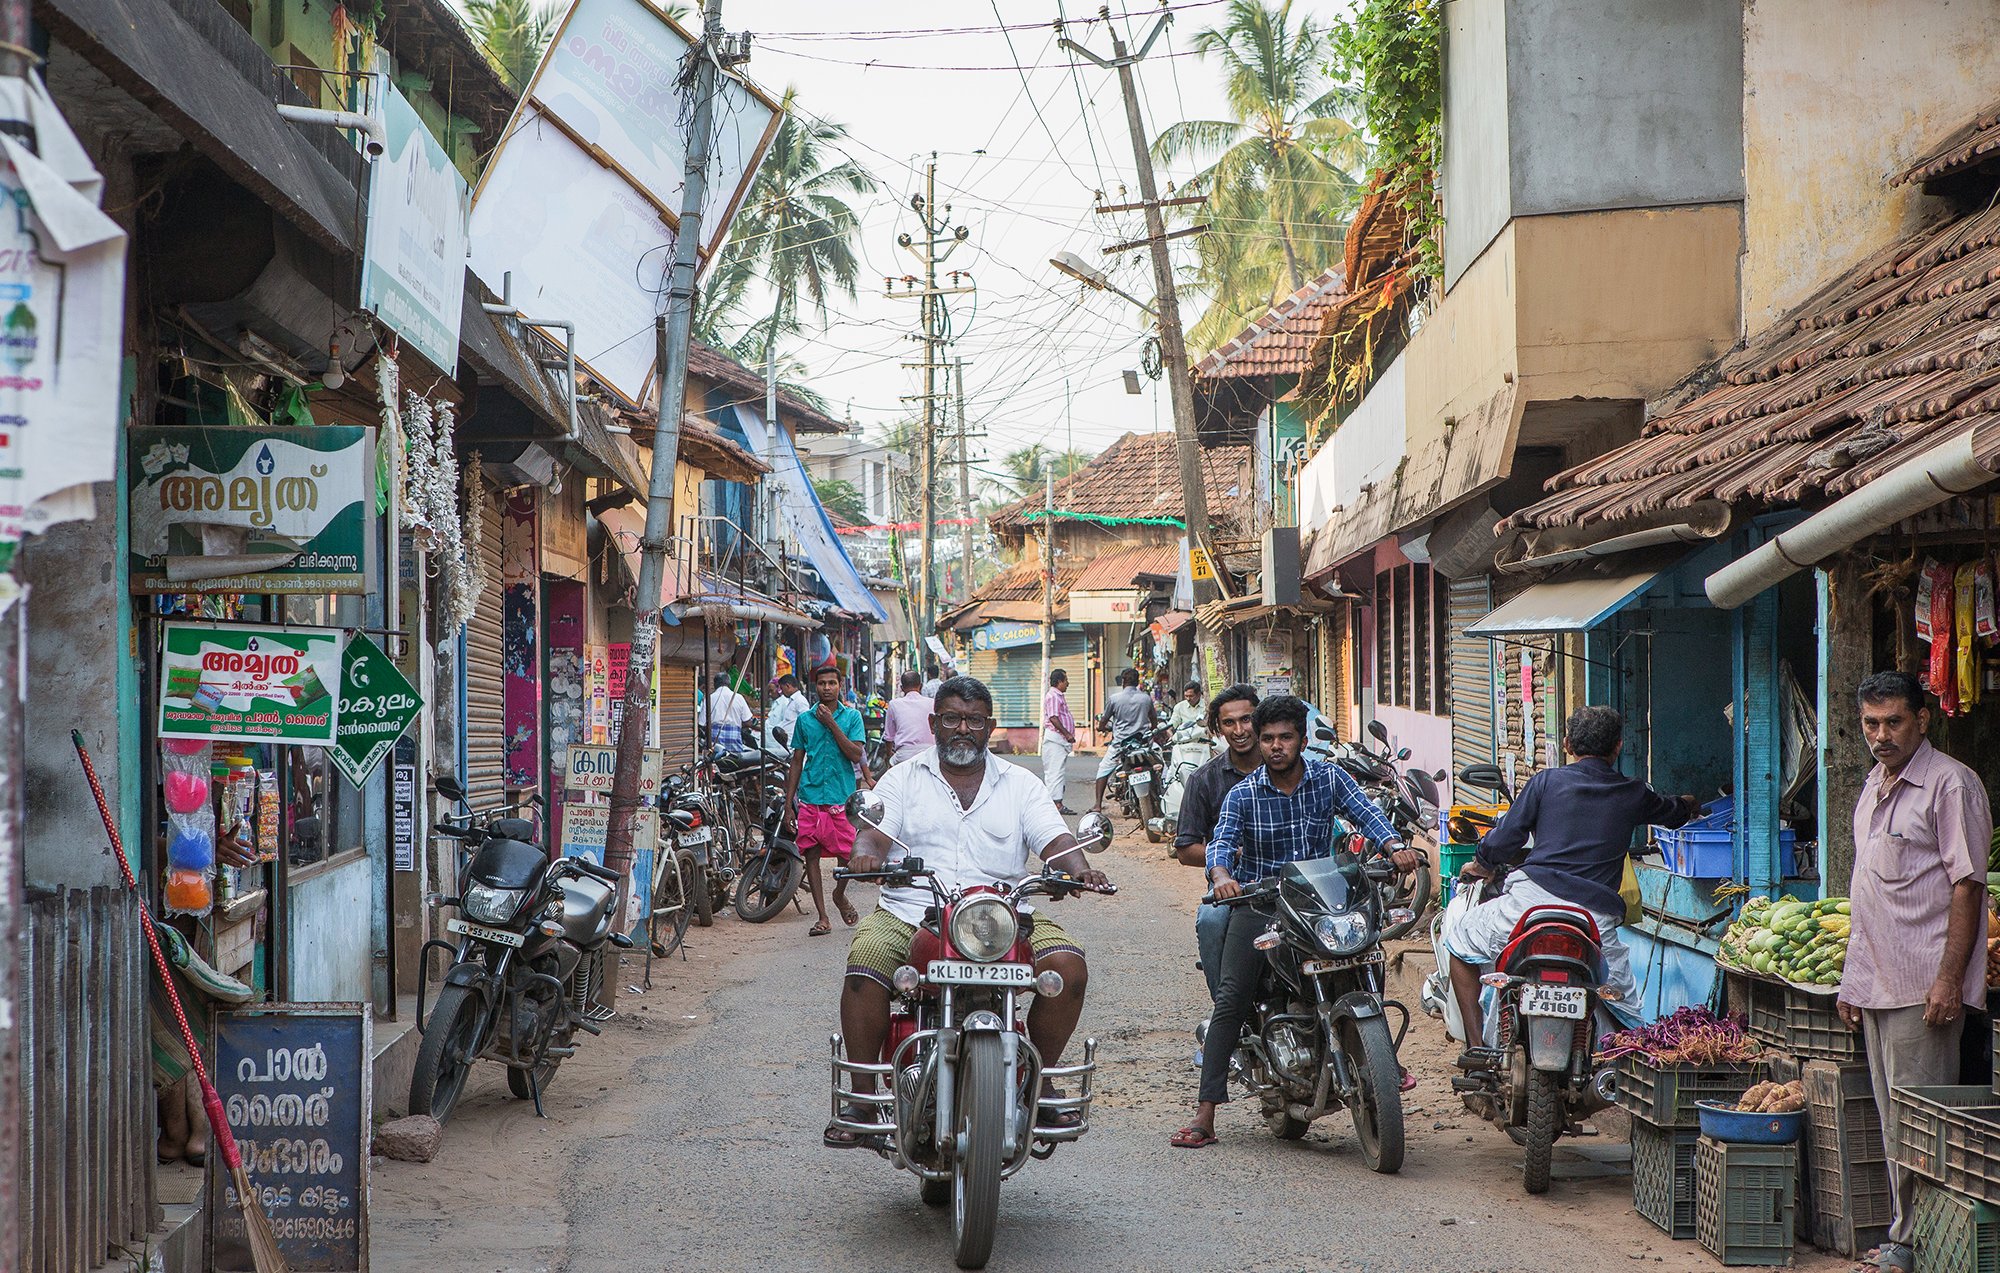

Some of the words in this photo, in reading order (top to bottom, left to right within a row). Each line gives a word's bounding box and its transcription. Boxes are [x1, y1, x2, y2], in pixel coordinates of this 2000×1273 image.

[160, 464, 328, 526] അമൃത്
[299, 551, 357, 571] ലഭിക്കുന്നു
[1002, 627, 1037, 641] SALOON
[202, 650, 305, 681] അമൃത്
[231, 680, 272, 691] മിൽക്ക്
[285, 713, 330, 727] തൈര്
[457, 924, 467, 933] KL
[1534, 990, 1551, 1000] KL
[1554, 991, 1571, 1002] 54
[1528, 1000, 1537, 1010] F
[1540, 1001, 1578, 1014] 4160
[237, 1042, 328, 1083] പാൽ
[226, 1086, 335, 1127] തൈര്
